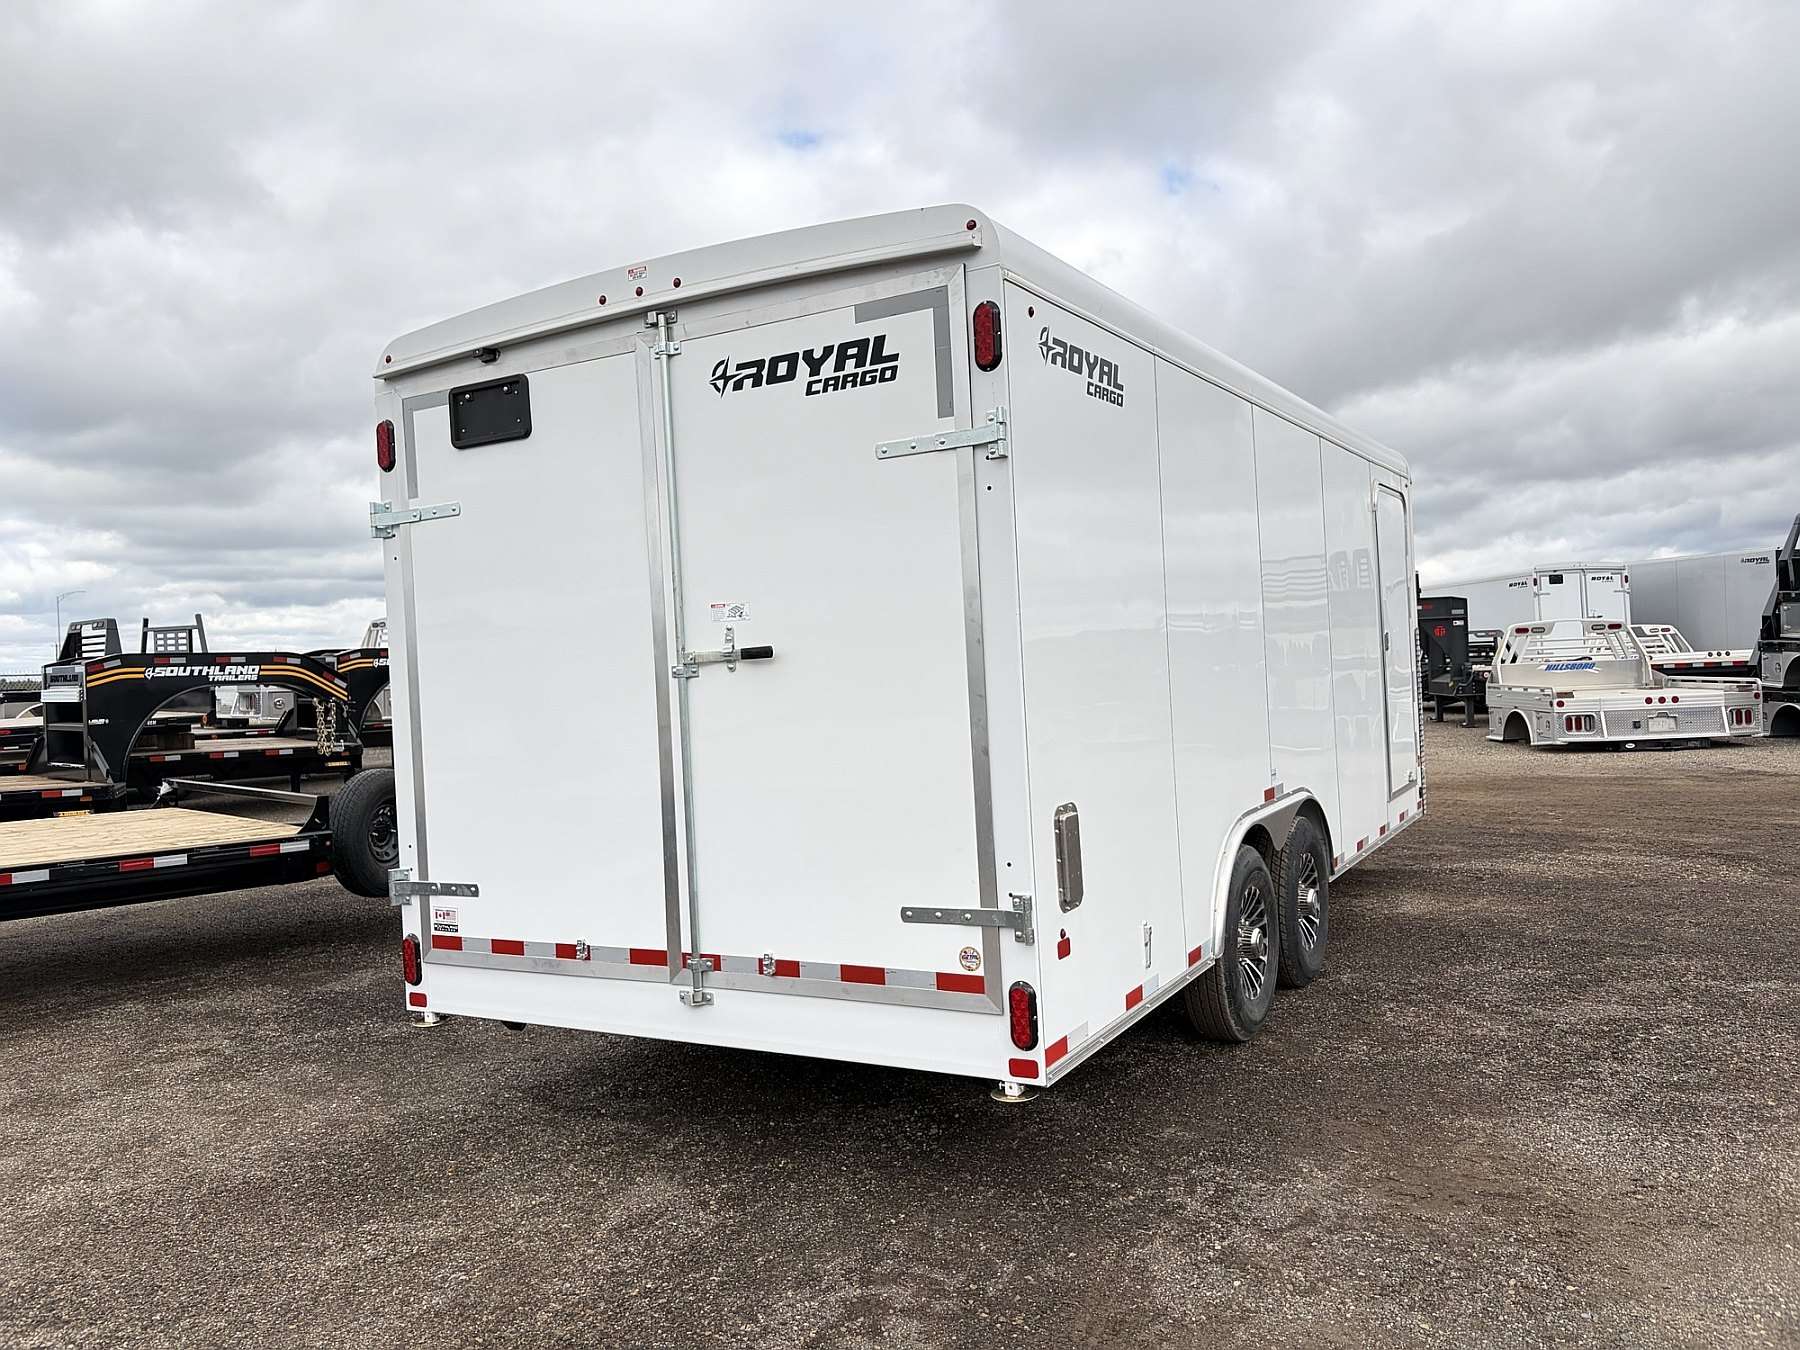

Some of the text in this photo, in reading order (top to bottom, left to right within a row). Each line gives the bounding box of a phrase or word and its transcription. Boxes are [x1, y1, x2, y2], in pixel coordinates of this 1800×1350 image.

[732, 334, 899, 392] ROYAL
[1051, 337, 1124, 391] ROYAL
[805, 365, 899, 396] CARGO
[1087, 381, 1124, 407] CARGO
[153, 665, 260, 677] SOUTHLAND
[1545, 662, 1596, 671] HILLSBORO
